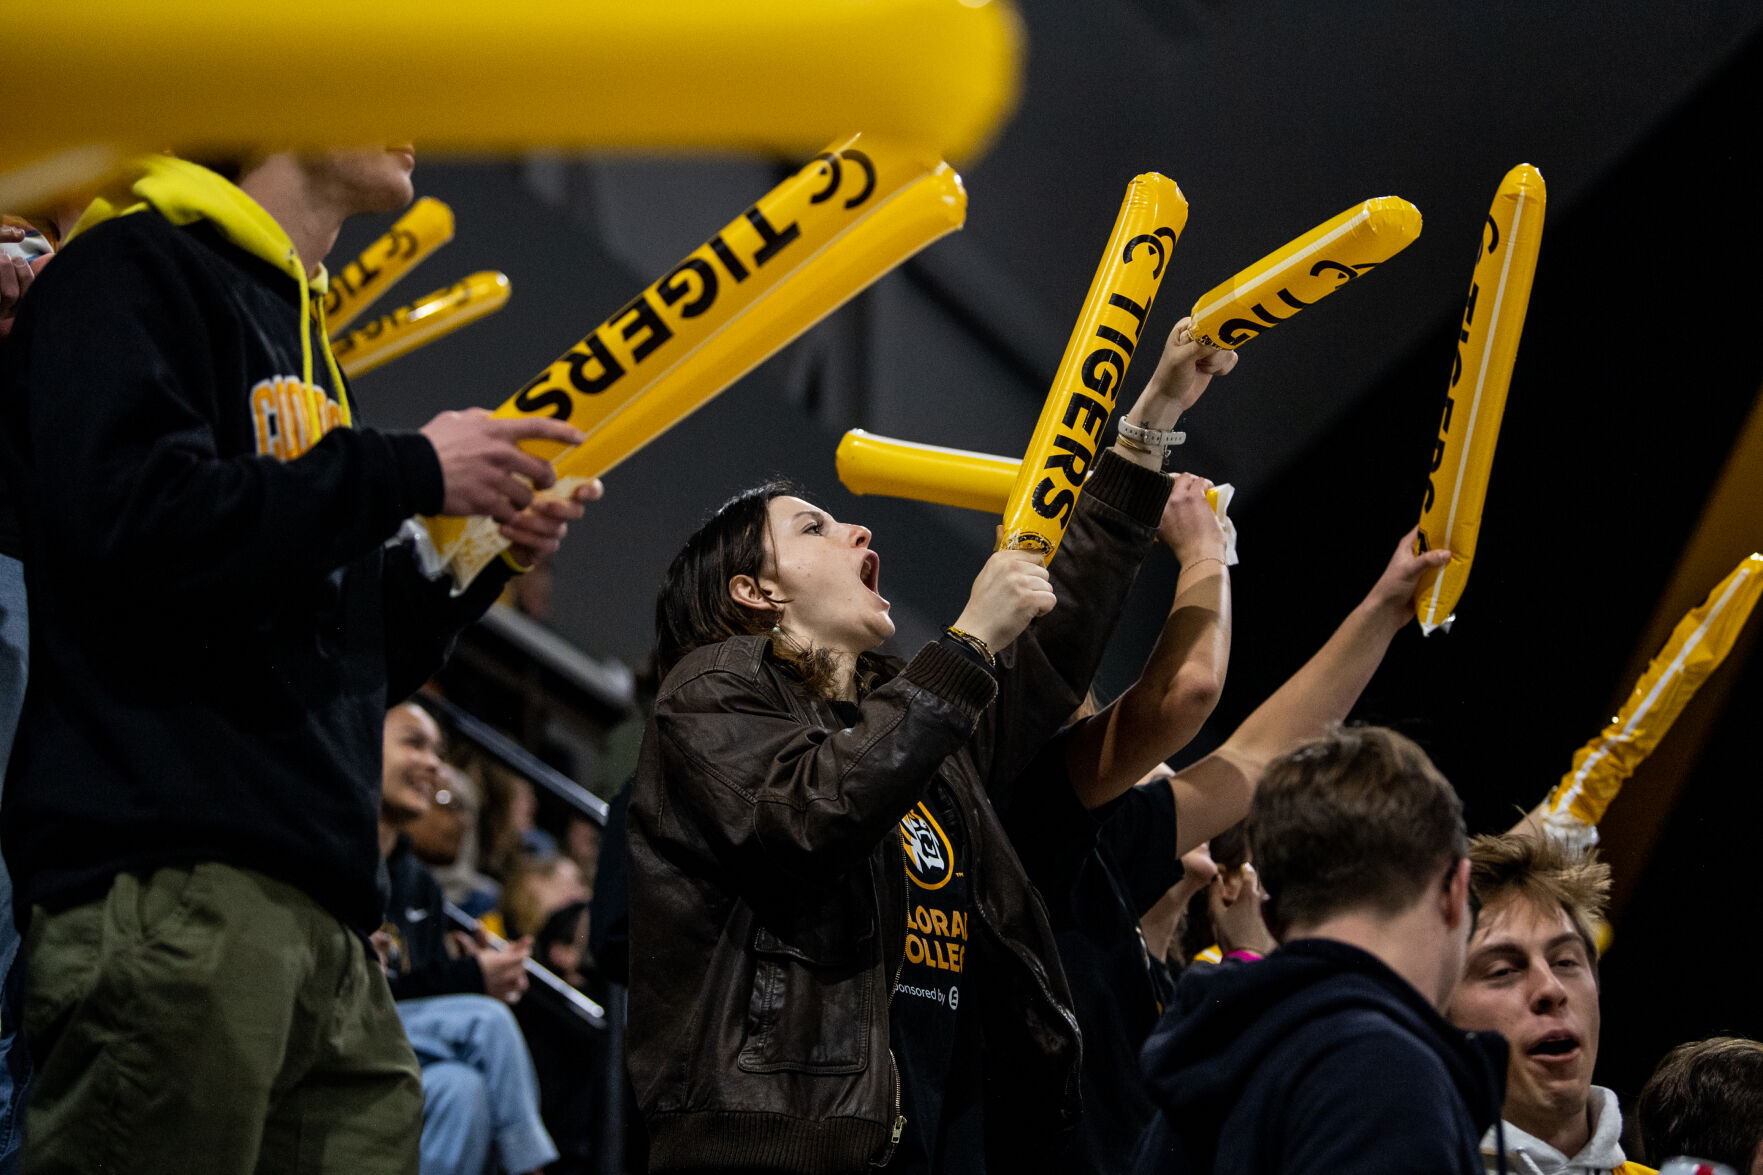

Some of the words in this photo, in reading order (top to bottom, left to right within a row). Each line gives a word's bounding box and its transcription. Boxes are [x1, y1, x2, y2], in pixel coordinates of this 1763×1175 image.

[514, 207, 801, 423] TIGERS
[1031, 292, 1152, 530] TIGERS
[905, 933, 965, 973] OLLE
[937, 988, 946, 1005] by
